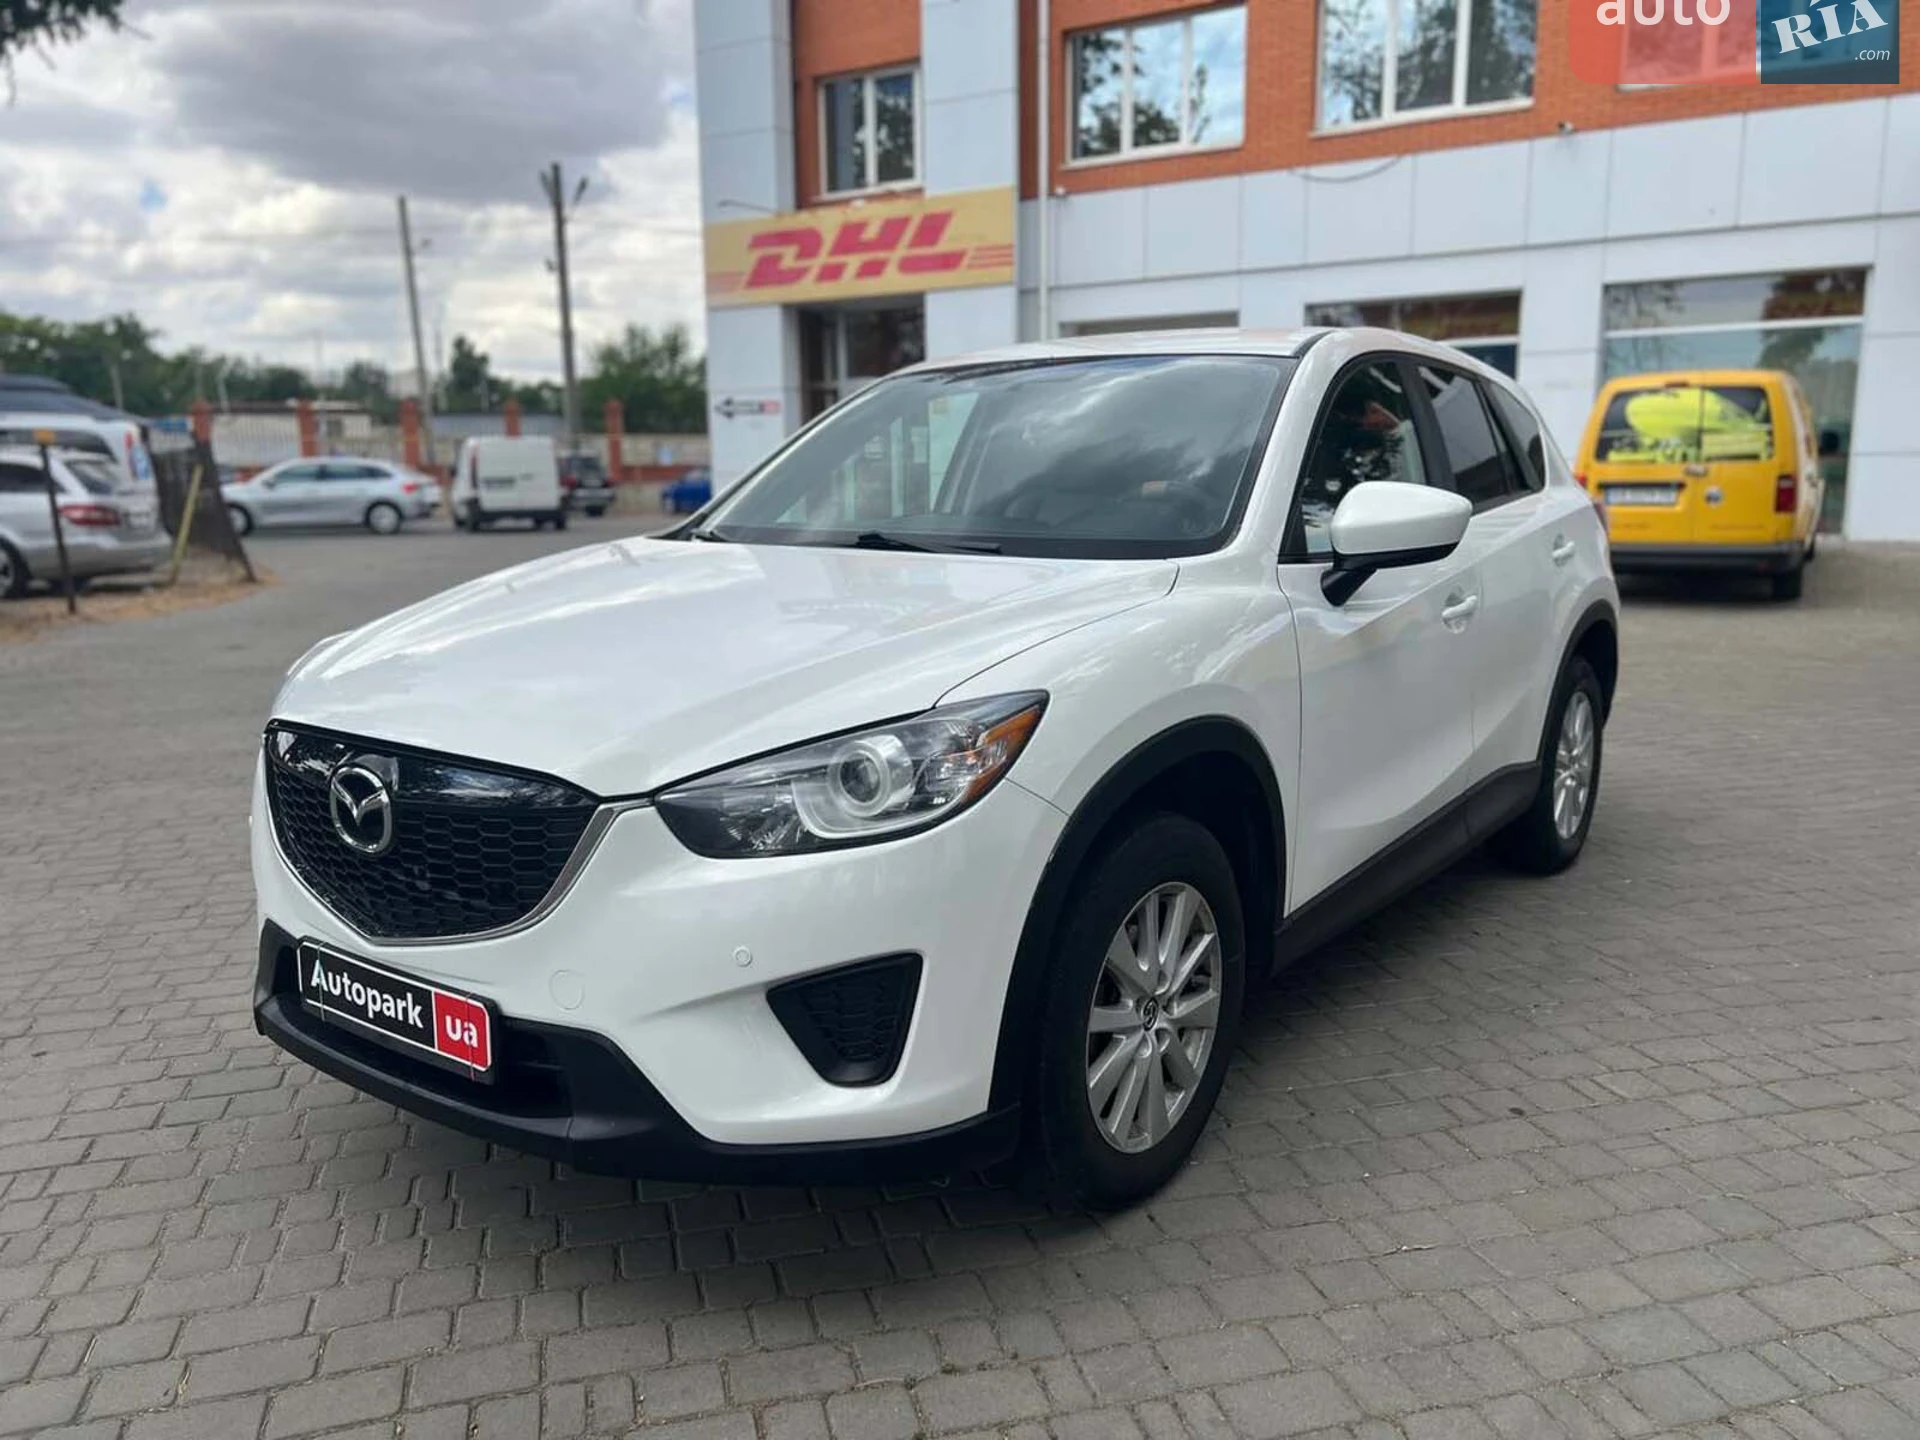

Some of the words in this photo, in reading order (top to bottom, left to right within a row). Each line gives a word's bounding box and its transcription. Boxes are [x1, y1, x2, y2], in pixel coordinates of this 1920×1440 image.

[745, 211, 968, 289] DHL
[310, 959, 424, 1029] Autopark
[444, 1014, 478, 1048] ua
